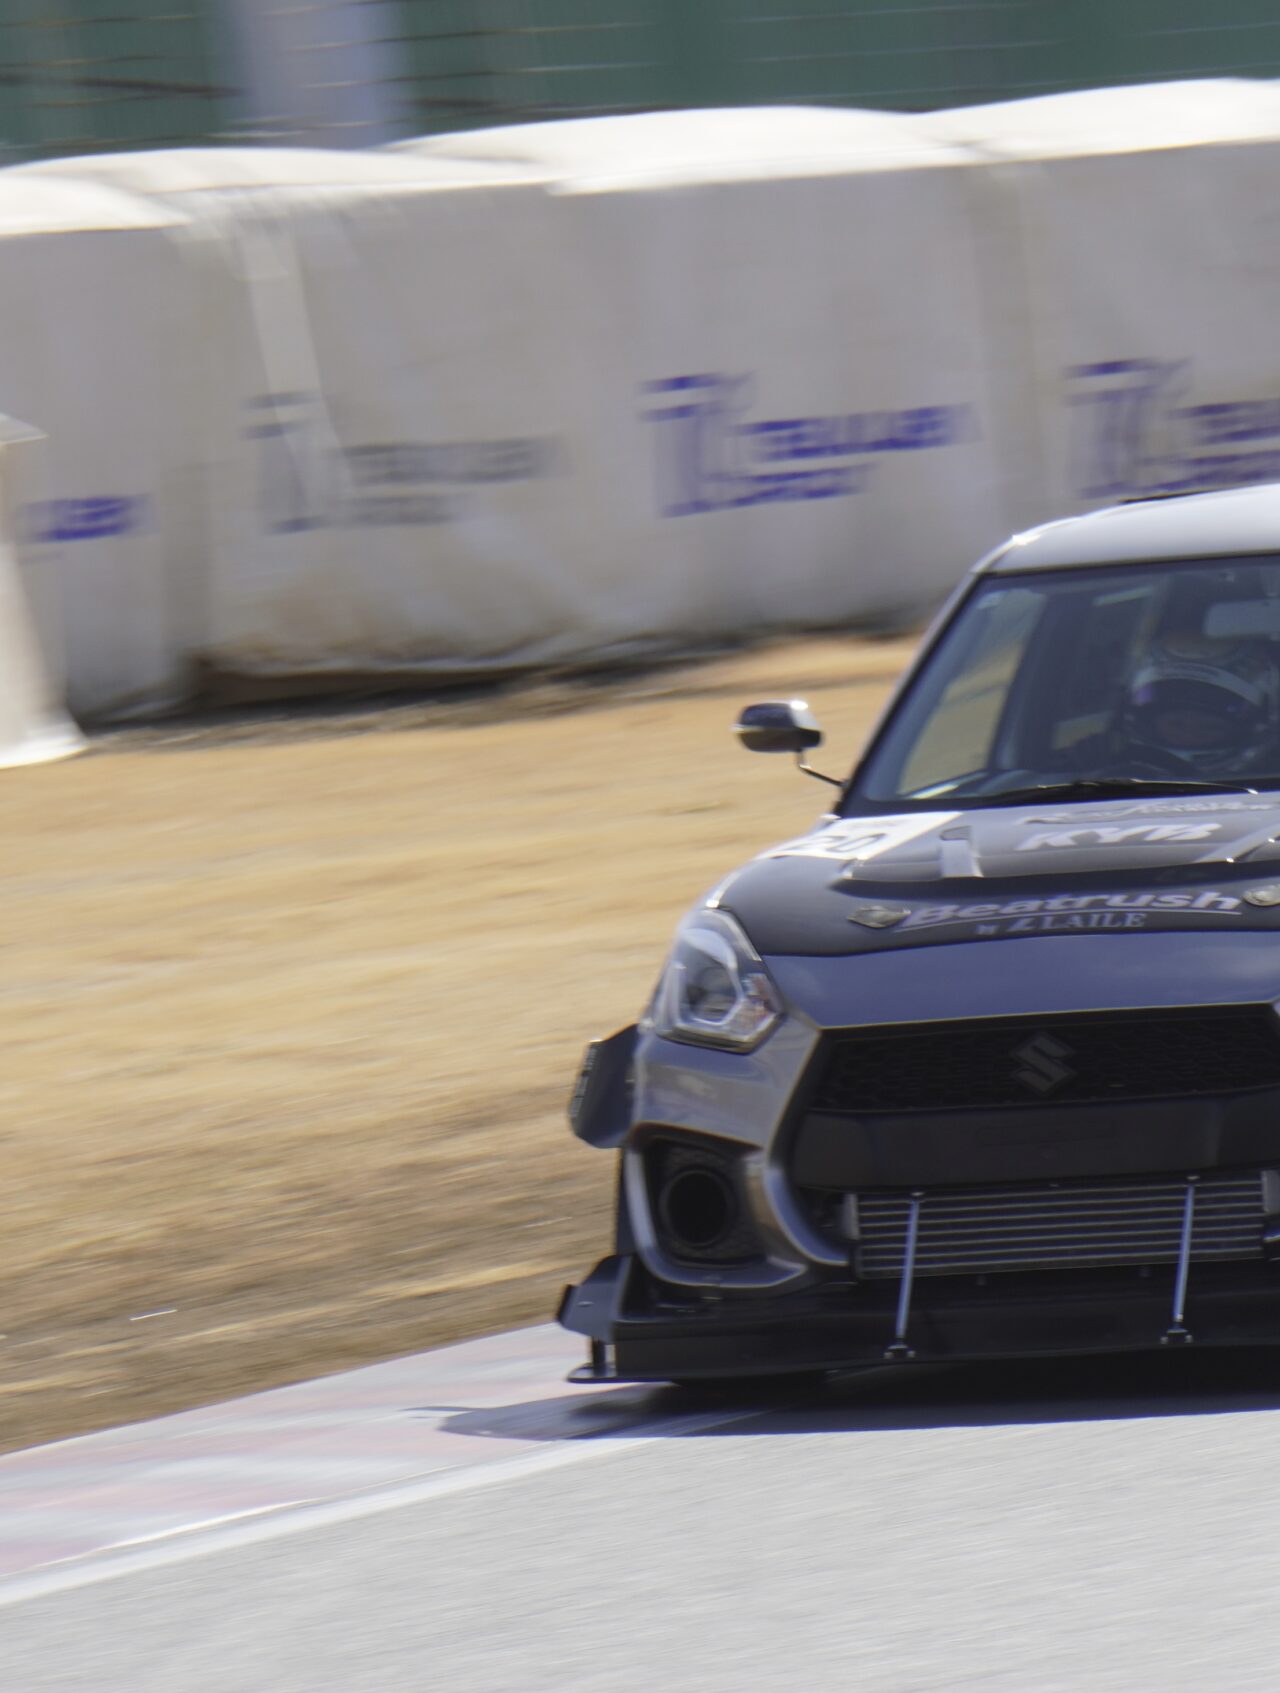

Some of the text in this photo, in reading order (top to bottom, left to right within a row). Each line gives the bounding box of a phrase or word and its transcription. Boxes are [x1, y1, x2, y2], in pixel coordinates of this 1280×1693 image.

[1015, 823, 1222, 851] KYB
[902, 891, 1242, 928] Beatrush
[1037, 911, 1147, 931] LAILE
